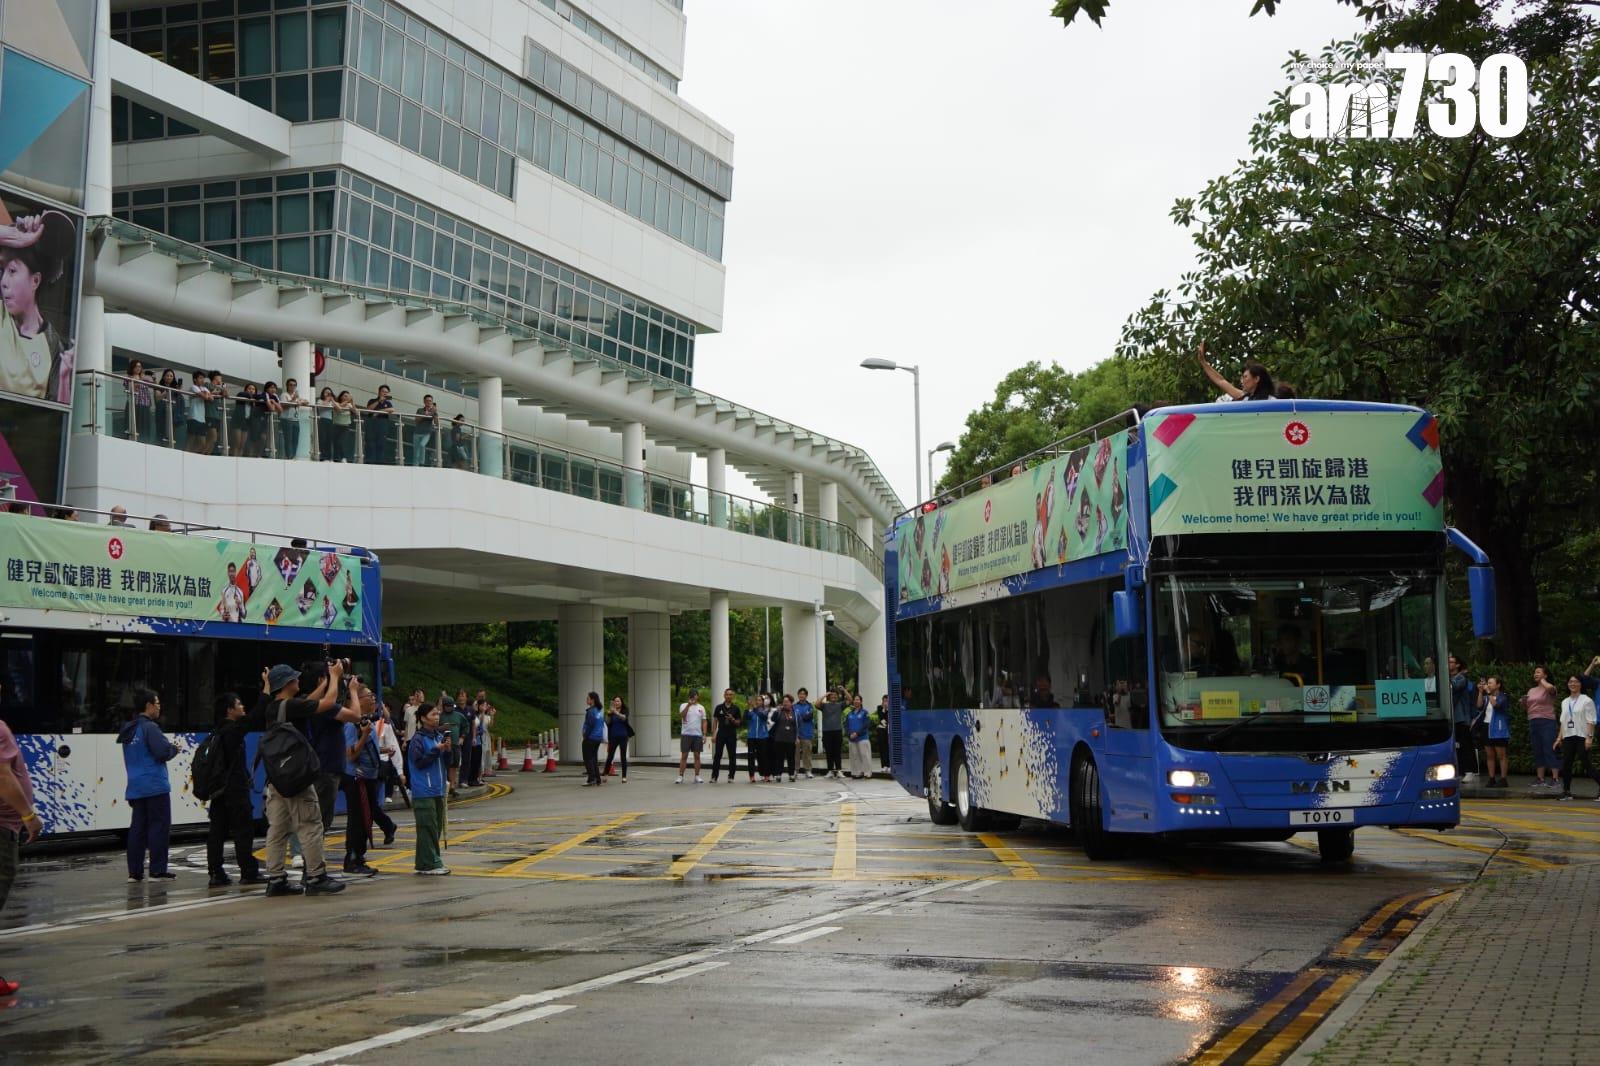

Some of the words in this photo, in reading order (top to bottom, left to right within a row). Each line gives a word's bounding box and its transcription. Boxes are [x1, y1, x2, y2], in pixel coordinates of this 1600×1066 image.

[1231, 458, 1369, 480] 健兒凱旋歸港
[1234, 484, 1371, 507] 我們深以為傲
[1181, 514, 1233, 524] Welcome
[1236, 513, 1270, 523] home!
[1273, 512, 1290, 522] We
[1293, 512, 1319, 522] have
[1321, 512, 1349, 524] great
[1352, 511, 1380, 523] pride
[1382, 511, 1393, 521] in
[1395, 511, 1422, 523] you!!
[7, 557, 112, 590] 健兒凱旋歸港
[120, 569, 212, 598] 我們深以為傲
[31, 586, 67, 599] Welcome
[69, 591, 93, 601] home!
[95, 592, 106, 602] We
[108, 594, 126, 604] have
[127, 596, 146, 606] great
[147, 598, 166, 608] pride
[1381, 691, 1409, 705] BUS
[1411, 691, 1422, 705] A
[1291, 780, 1350, 793] MAN
[1302, 811, 1342, 823] TOYO
